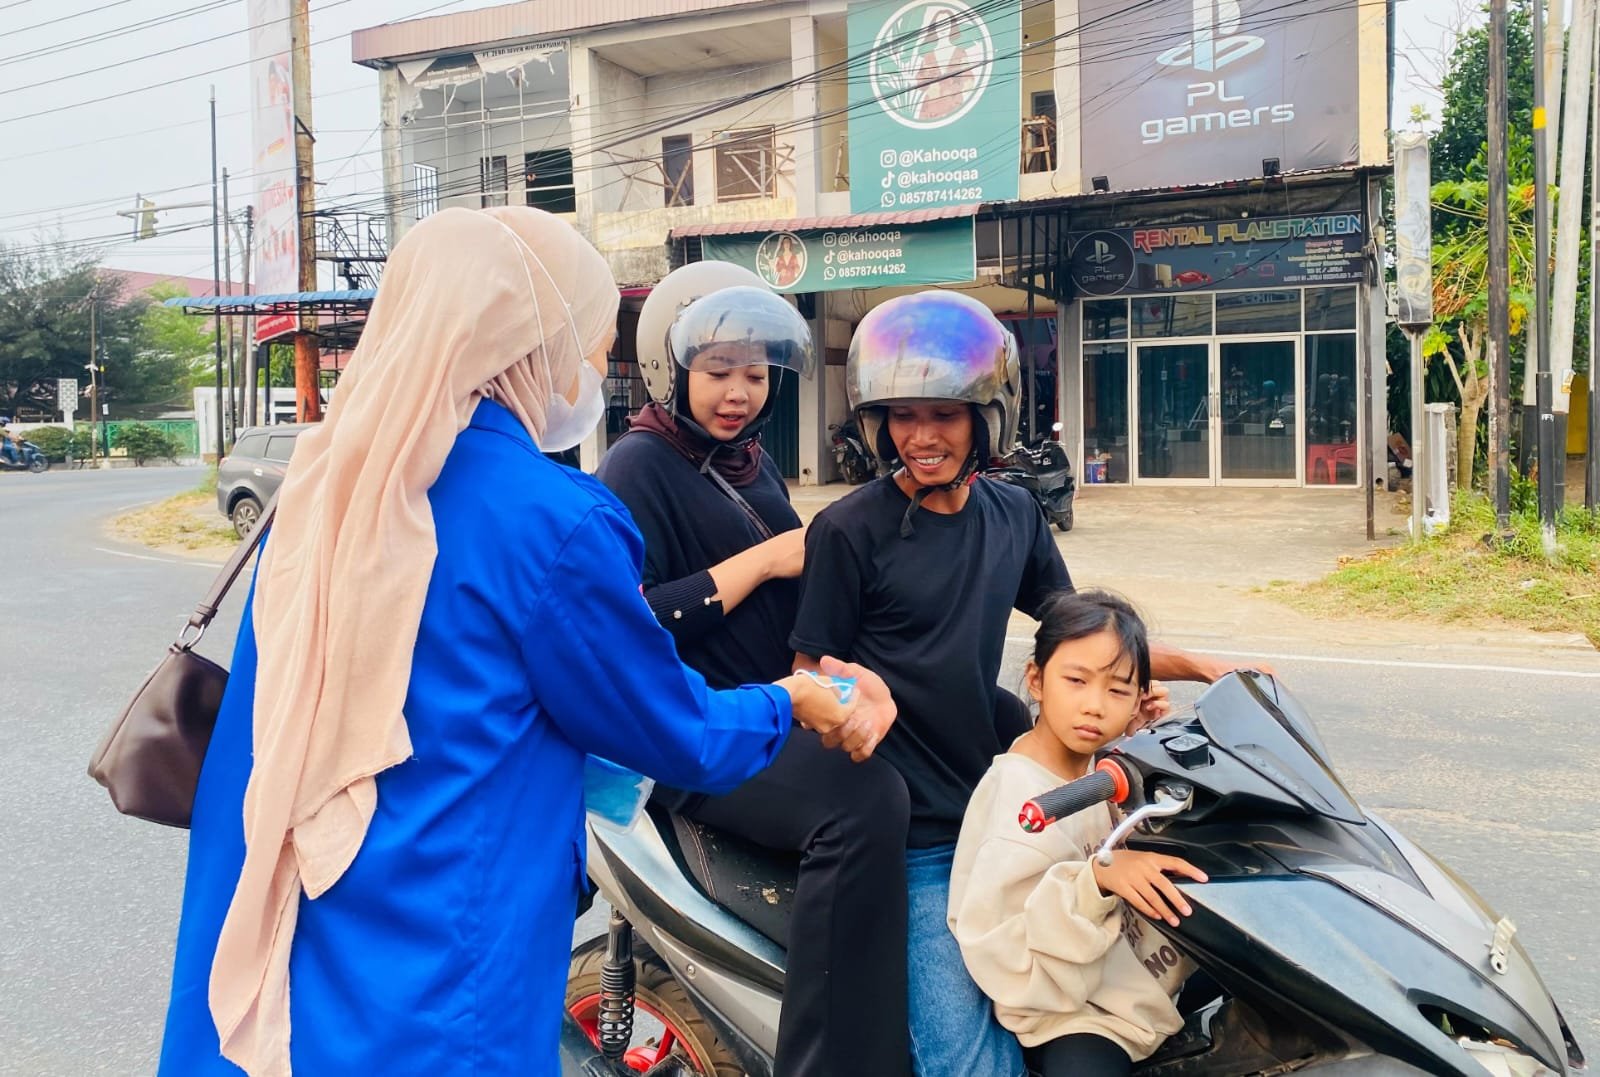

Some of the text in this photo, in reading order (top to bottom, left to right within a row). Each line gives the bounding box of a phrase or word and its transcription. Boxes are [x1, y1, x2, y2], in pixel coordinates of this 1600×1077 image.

[1187, 80, 1244, 107] PL
[1140, 103, 1295, 145] gamers
[899, 147, 977, 167] @Kahooqa
[897, 169, 978, 188] @kahooqaa
[899, 187, 983, 204] 085787414262
[838, 231, 901, 246] @Kahooqa
[1133, 215, 1361, 253] RENTAL PLAYSTATION
[837, 248, 903, 264] @kahooqaa
[838, 263, 906, 278] 085787414262
[1081, 273, 1125, 284] gamers
